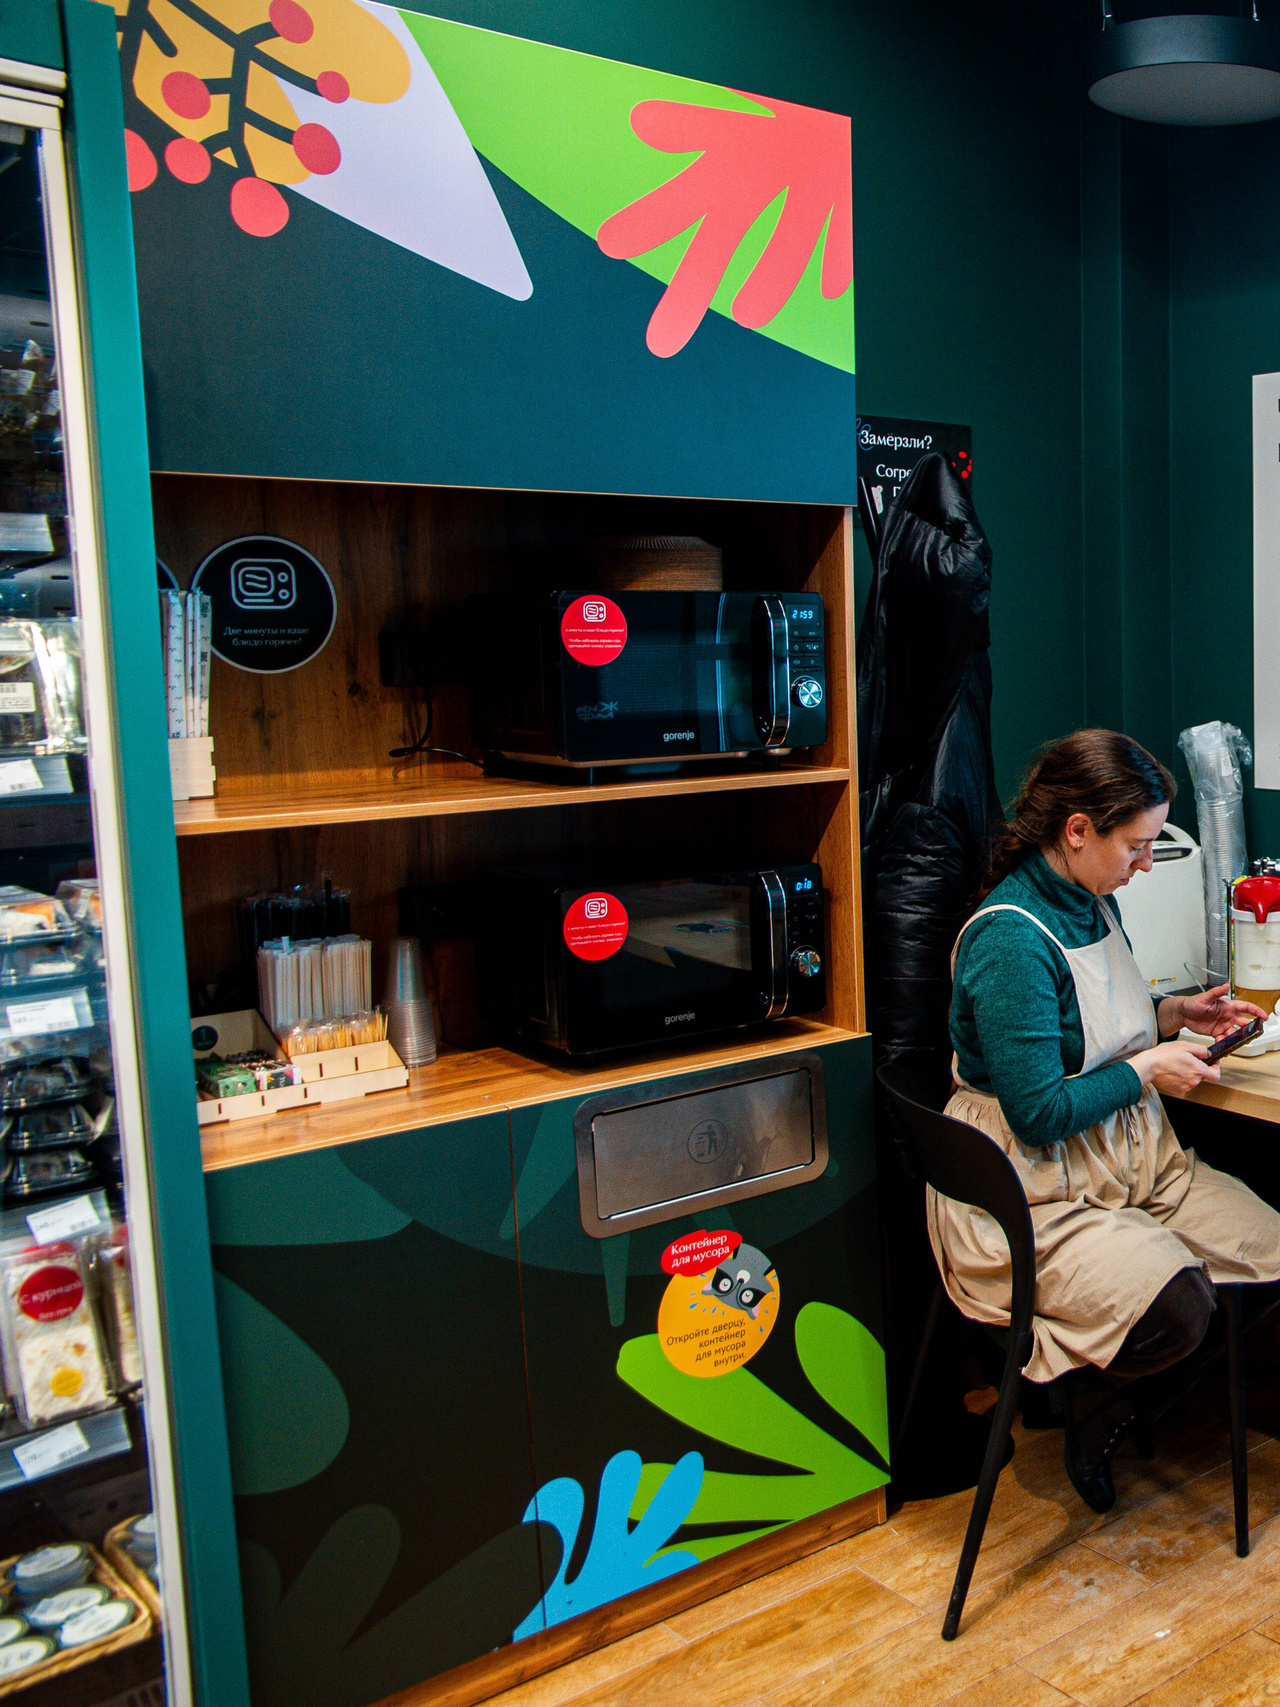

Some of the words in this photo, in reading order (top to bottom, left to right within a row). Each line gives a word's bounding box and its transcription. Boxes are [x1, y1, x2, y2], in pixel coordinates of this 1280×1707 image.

[860, 430, 933, 451] Замёрзли?
[663, 730, 695, 742] gorenje
[664, 1011, 696, 1025] gorenje
[671, 1235, 728, 1255] Контейнер
[671, 1254, 691, 1268] для
[692, 1246, 730, 1262] мусора
[666, 1328, 710, 1346] Откройте
[712, 1318, 746, 1336] дверцу,
[699, 1329, 746, 1348] контейнер
[695, 1352, 712, 1362] для
[714, 1341, 746, 1356] мусора
[714, 1352, 747, 1367] внутри.
